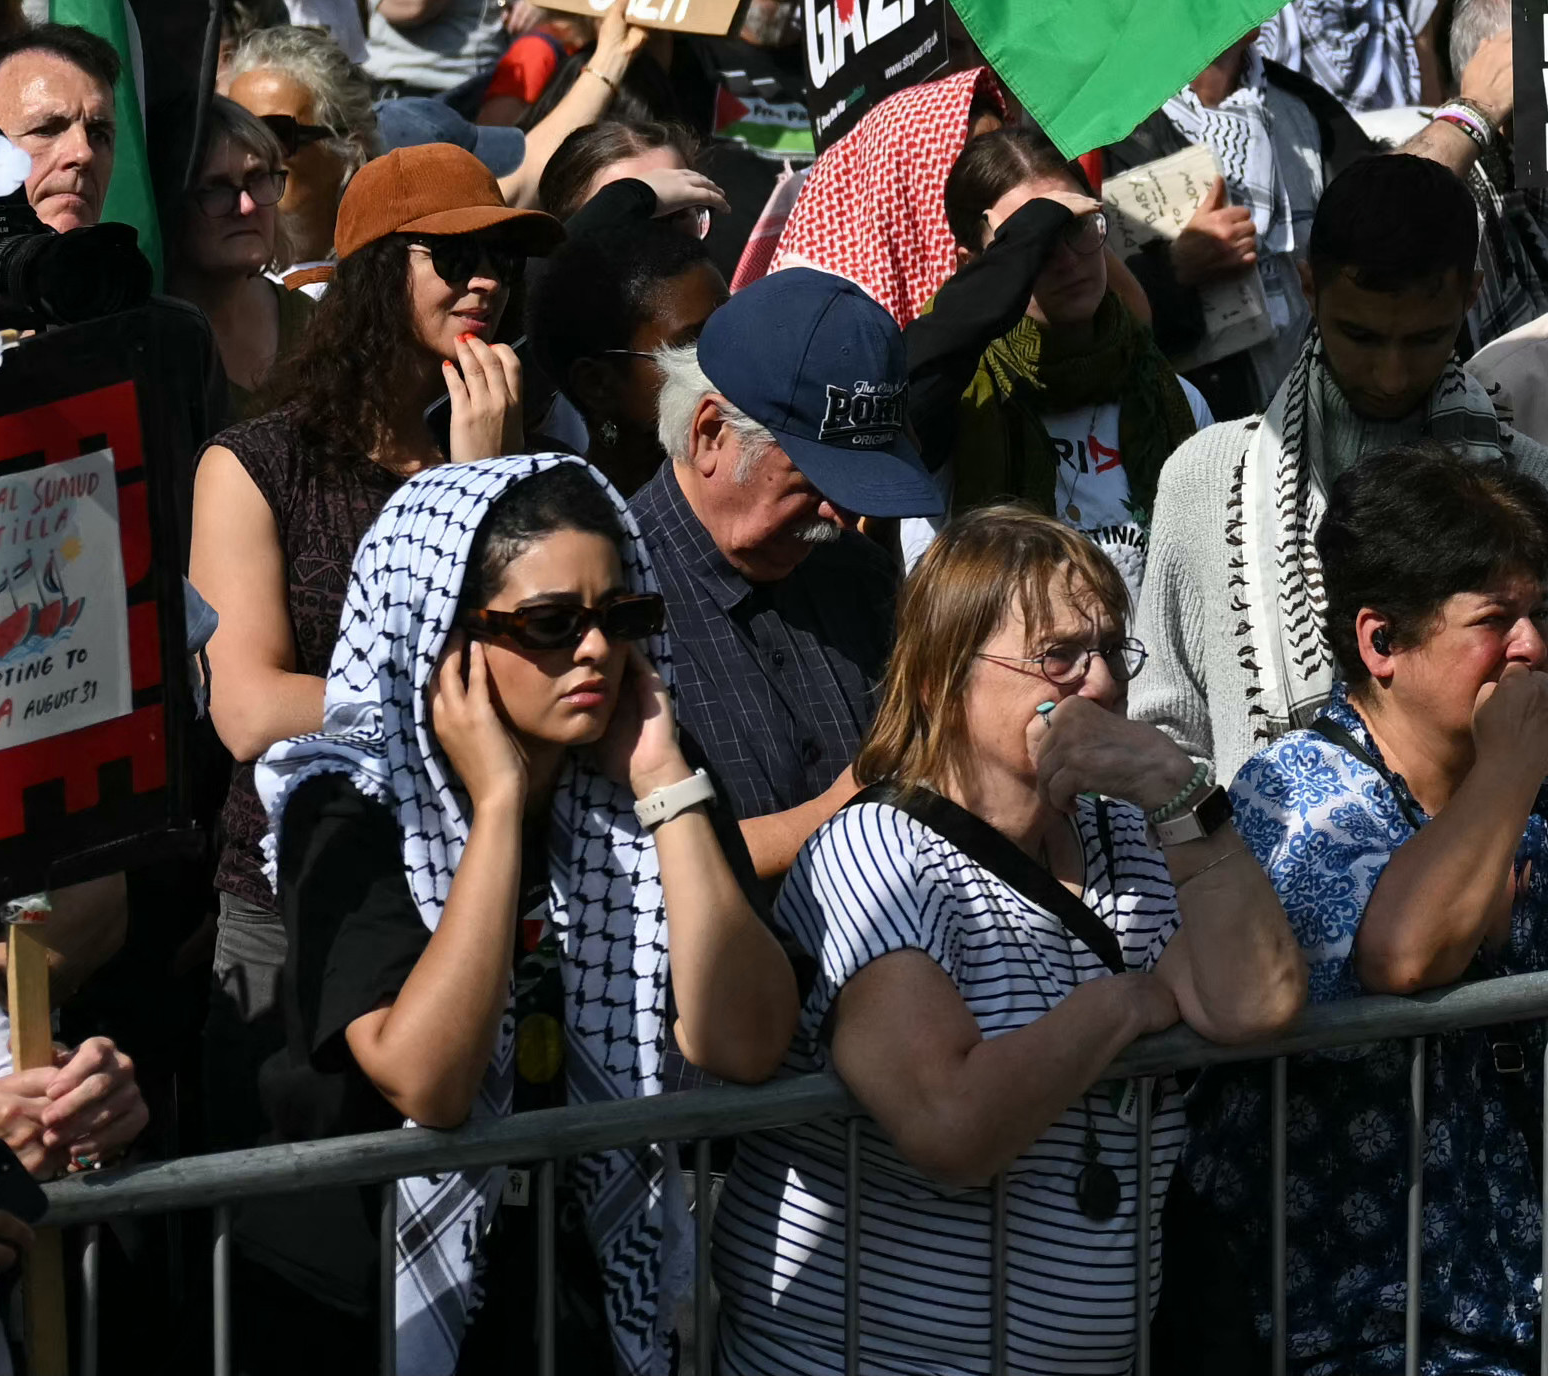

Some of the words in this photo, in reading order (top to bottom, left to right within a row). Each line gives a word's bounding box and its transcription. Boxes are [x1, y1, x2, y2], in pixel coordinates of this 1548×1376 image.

[853, 380, 876, 395] The
[32, 471, 100, 514] SUMUD
[66, 647, 88, 670] TO
[23, 686, 79, 720] AUGUST
[79, 680, 98, 704] 31
